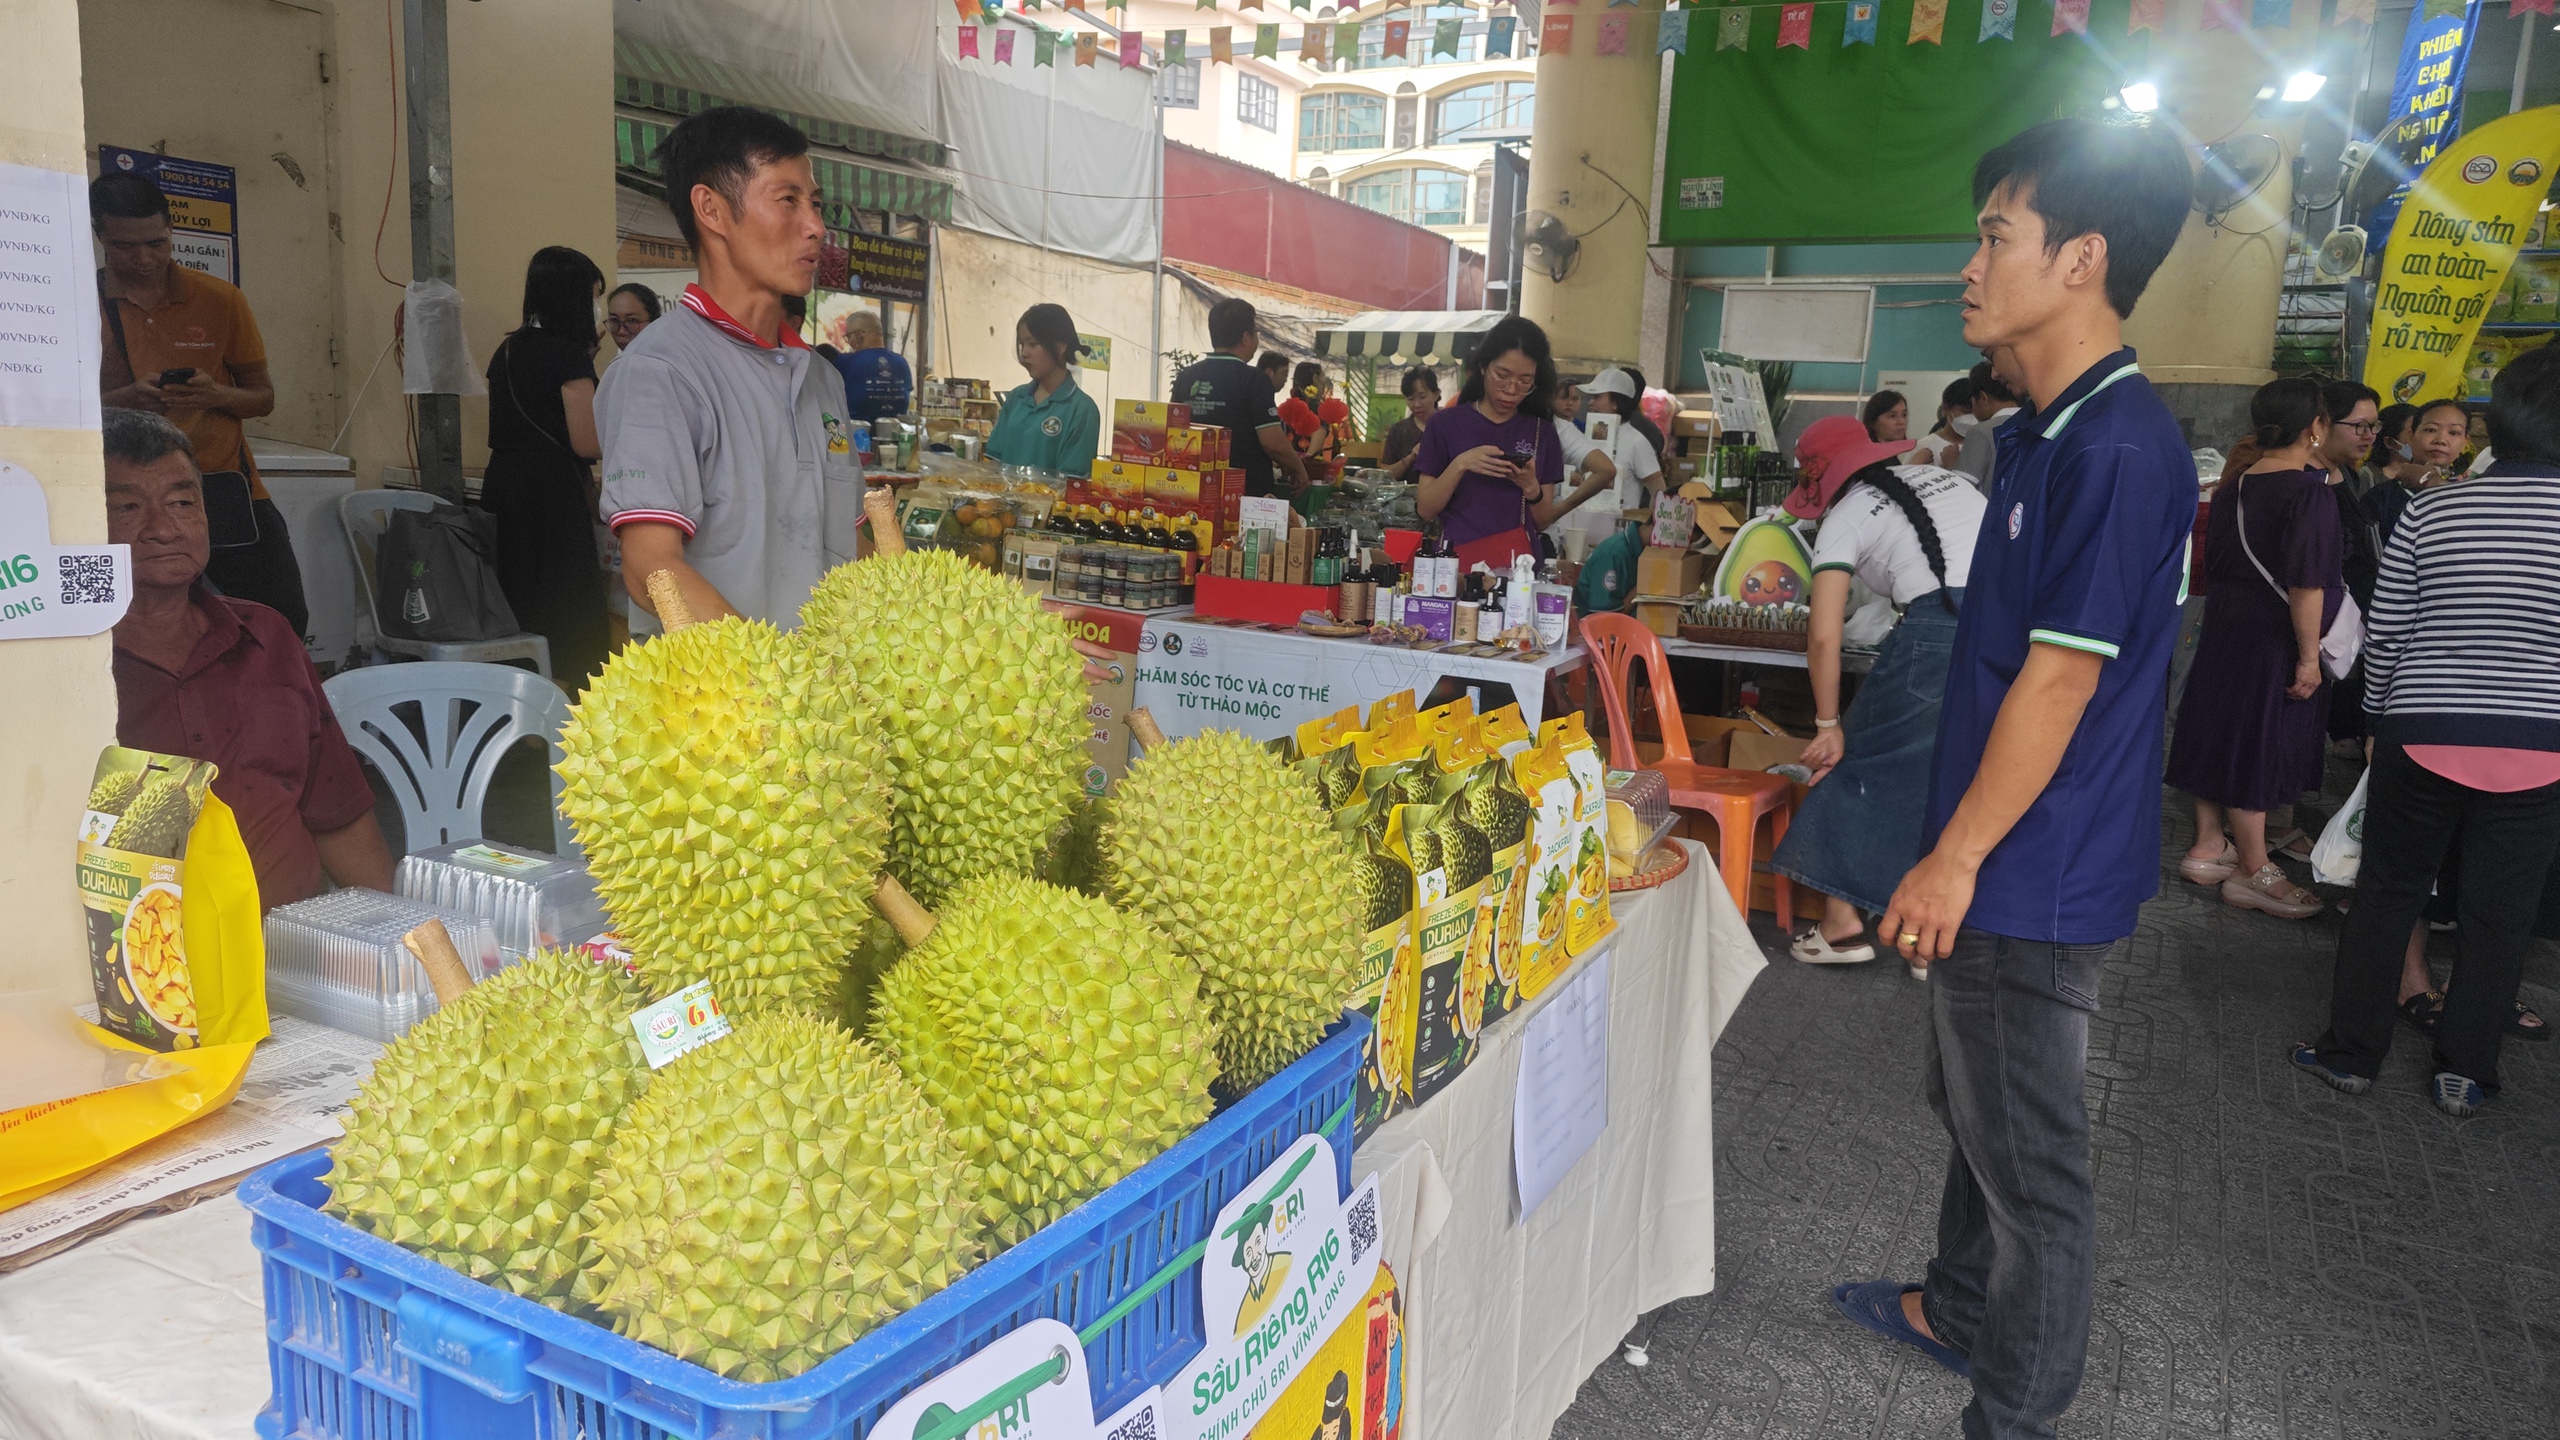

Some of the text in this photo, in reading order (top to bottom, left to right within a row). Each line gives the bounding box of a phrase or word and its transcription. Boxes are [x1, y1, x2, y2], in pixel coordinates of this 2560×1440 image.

[2419, 27, 2464, 60] PHIÊN
[160, 171, 184, 183] 1900
[187, 174, 200, 185] 54
[202, 177, 215, 187] 54
[217, 180, 230, 190] 54
[2409, 209, 2516, 247] Nông sản
[2401, 252, 2431, 276] an
[2380, 283, 2450, 318] Nguồn
[2382, 320, 2409, 349] rõ
[1421, 601, 1449, 609] MANDALA
[1181, 669, 1211, 689] SÓC
[1214, 672, 1244, 693] TÓC
[1248, 676, 1268, 696] VÀ
[1272, 682, 1296, 699] CƠ
[1298, 683, 1331, 703] THỂ
[1177, 690, 1281, 721] TỪ THẢO MỘC
[82, 869, 129, 898] DURIAN
[1426, 915, 1468, 950] DURIAN
[667, 1015, 677, 1026] RI
[1274, 1188, 1305, 1234] 6RI
[1192, 1356, 1240, 1416] Sầu
[1244, 1286, 1309, 1377] Riêng
[1241, 1376, 1269, 1420] CHỦ
[1270, 1352, 1290, 1391] 6RI
[1291, 1318, 1318, 1361] VĨNH
[1320, 1269, 1347, 1325] LONG
